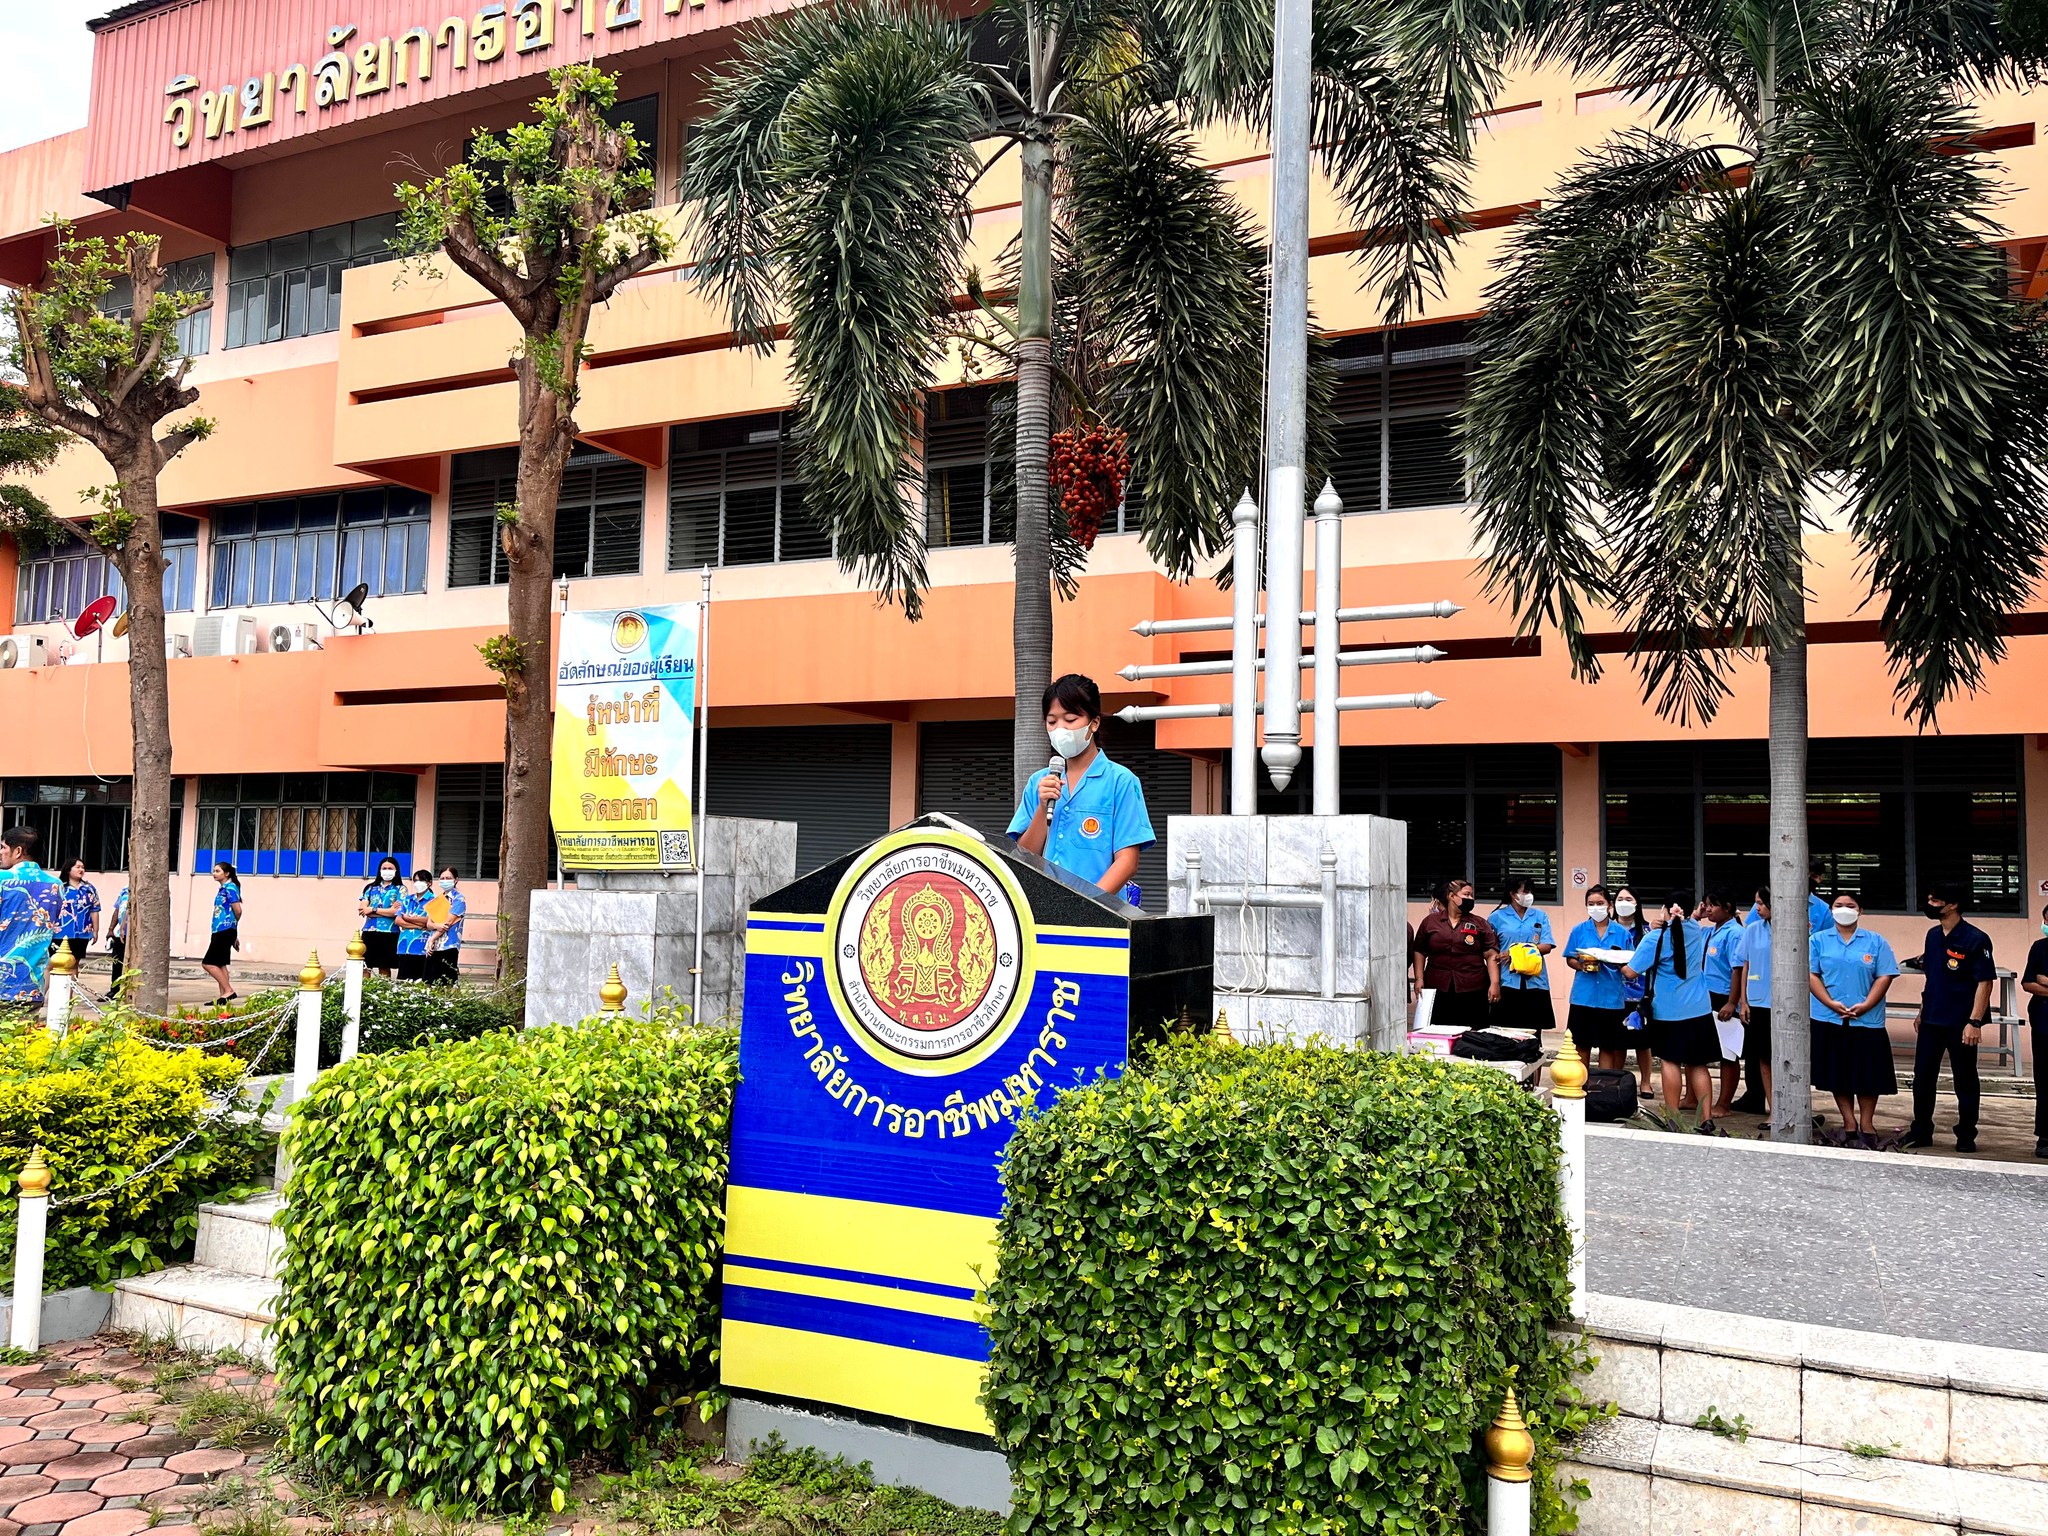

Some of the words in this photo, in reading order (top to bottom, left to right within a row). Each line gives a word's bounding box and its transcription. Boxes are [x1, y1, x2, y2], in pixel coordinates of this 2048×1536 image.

[587, 686, 660, 735] รู้หน้าที่
[584, 747, 658, 777] มีทักษะ
[580, 793, 658, 821] จิตอาสา
[856, 852, 999, 908] วิทยาลัยการอาชีพมหาราช
[848, 980, 1008, 1050] สำนักงานคณะกรรมการการอาชีวศึกษา
